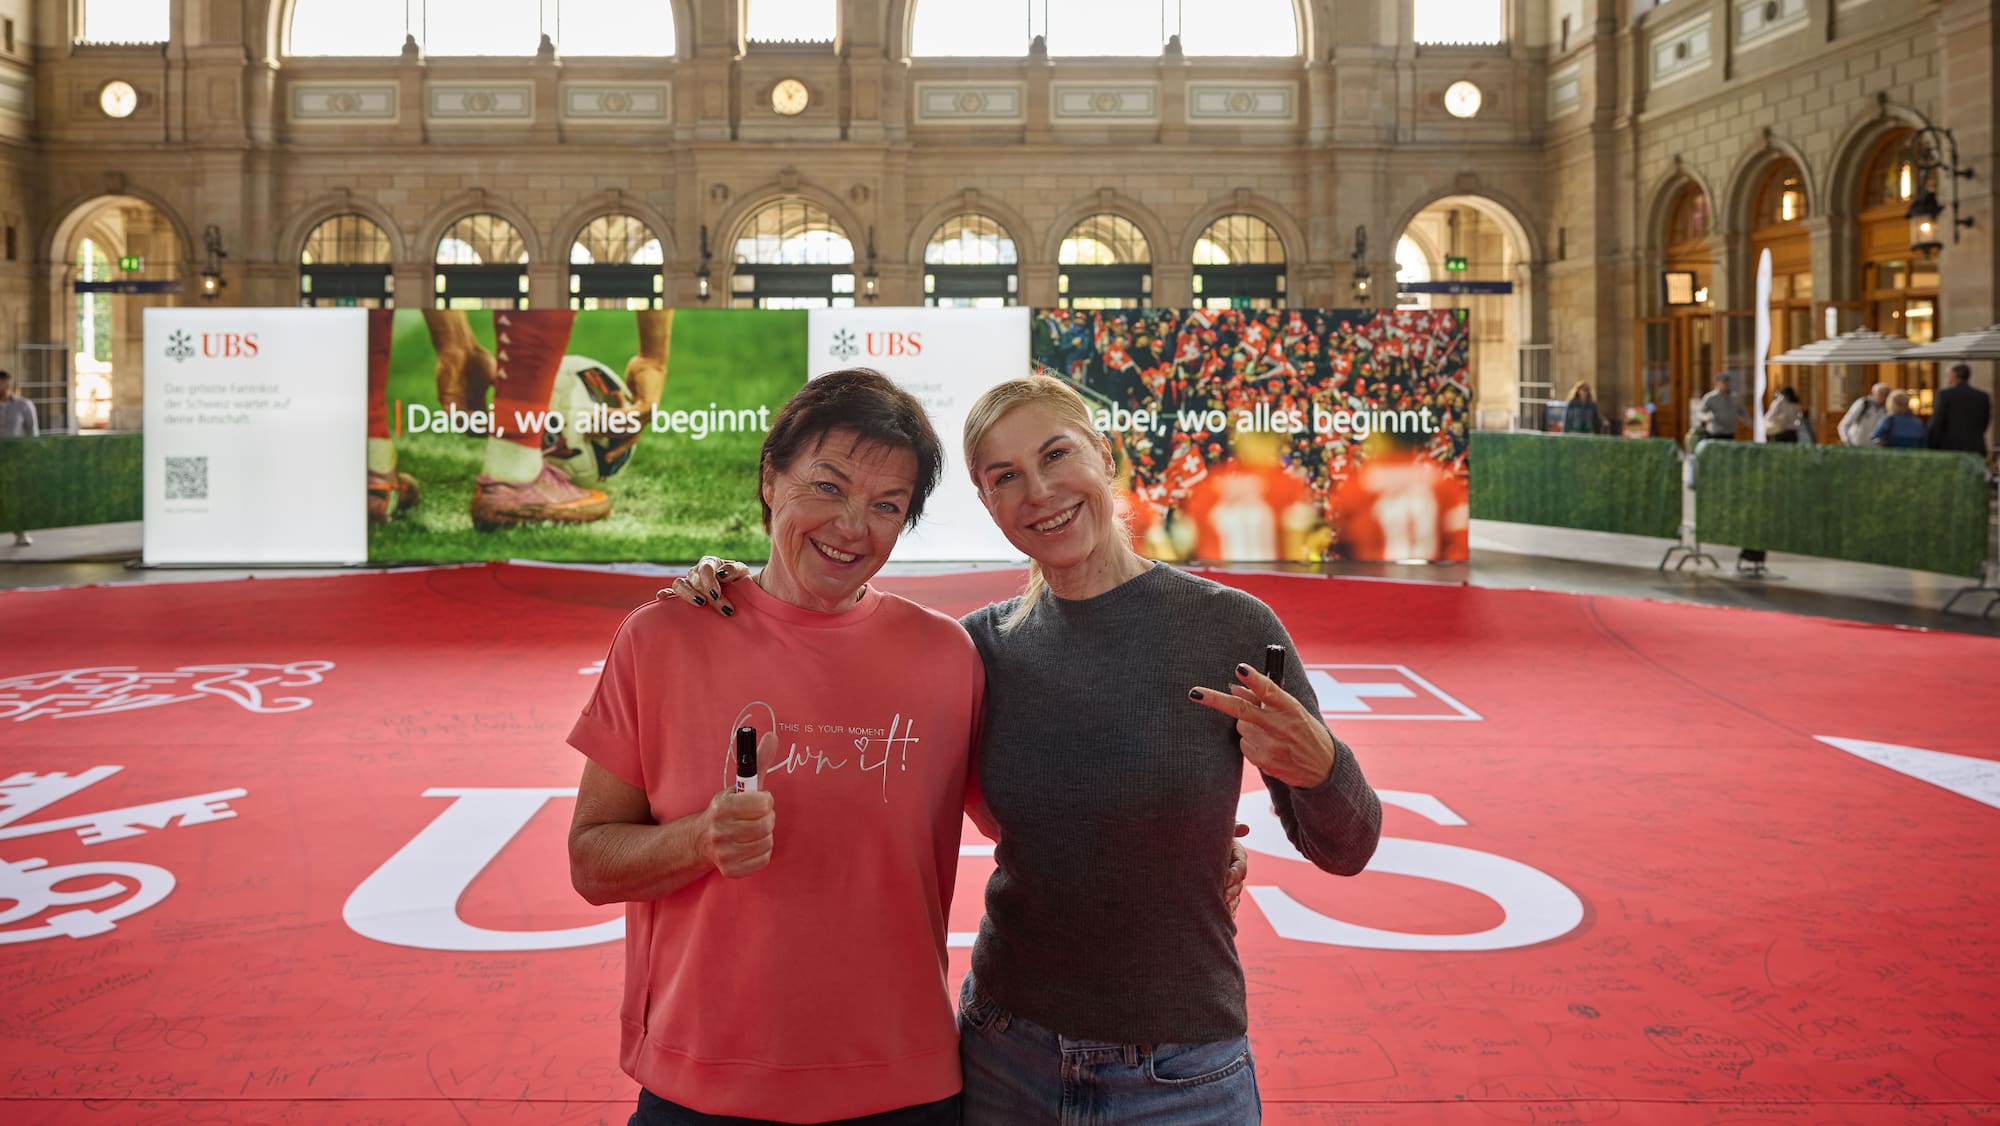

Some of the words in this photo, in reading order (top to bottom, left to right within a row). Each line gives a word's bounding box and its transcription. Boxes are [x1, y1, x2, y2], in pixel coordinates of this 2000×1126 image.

[202, 333, 259, 358] UBS
[866, 332, 922, 356] UBS
[407, 403, 505, 437] Dabei,
[515, 410, 564, 433] wo
[575, 403, 642, 433] alles
[1085, 401, 1167, 436] abei,
[1177, 410, 1227, 433] wo
[1235, 402, 1303, 433] alles
[1313, 402, 1440, 441] beginnt.
[778, 722, 799, 732] THIS
[804, 723, 814, 733] IS
[818, 724, 844, 734] YOUR
[848, 726, 886, 737] MOMENT
